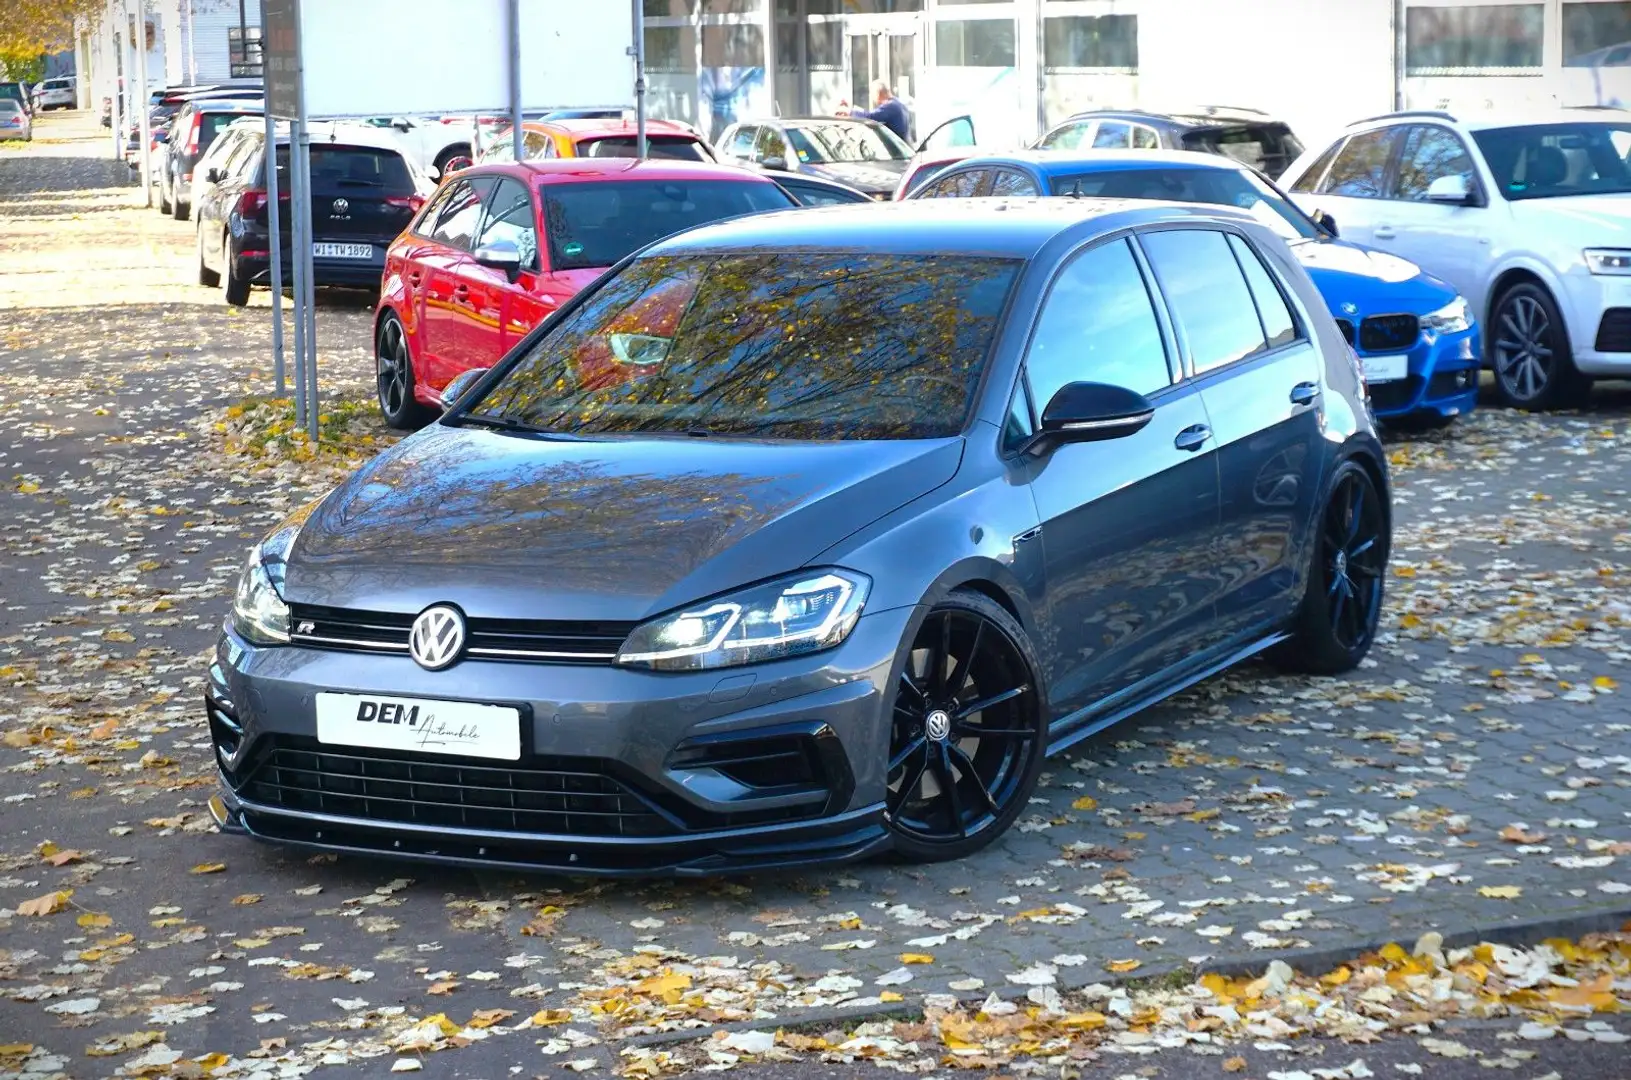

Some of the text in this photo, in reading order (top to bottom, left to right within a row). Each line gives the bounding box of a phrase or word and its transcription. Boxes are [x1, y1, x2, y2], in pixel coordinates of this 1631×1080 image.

[297, 621, 315, 634] R
[410, 607, 464, 668] VW
[356, 701, 481, 747] DEM Automobile
